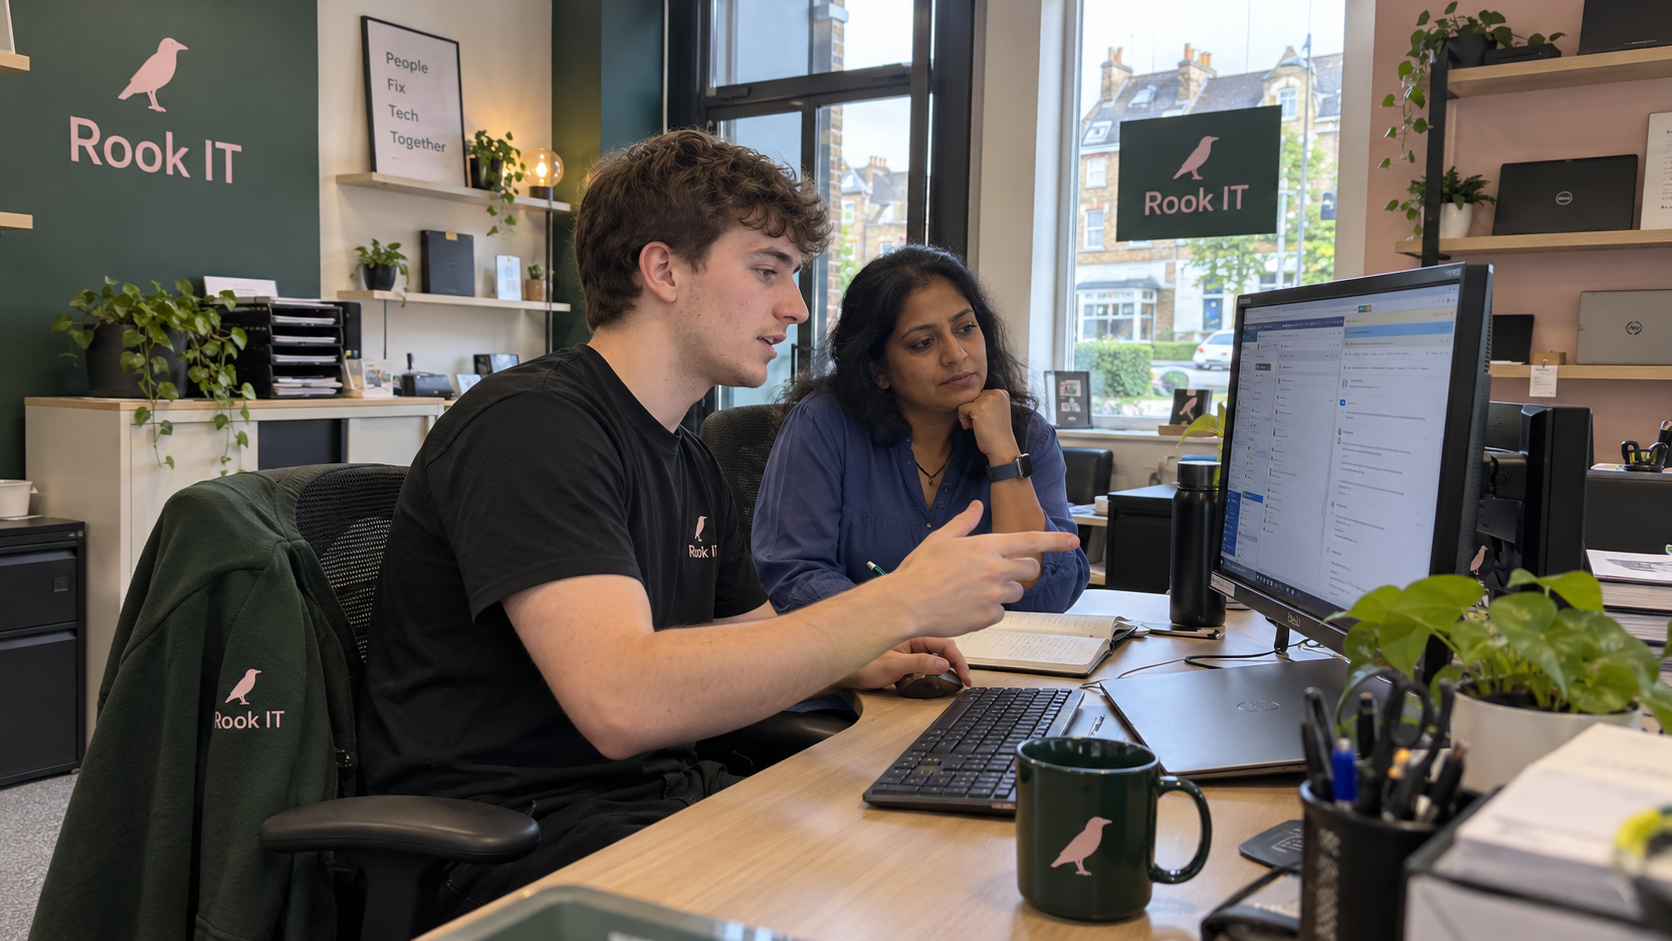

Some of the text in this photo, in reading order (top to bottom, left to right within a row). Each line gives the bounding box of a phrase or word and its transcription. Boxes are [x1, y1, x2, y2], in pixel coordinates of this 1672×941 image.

[386, 51, 429, 74] People
[387, 78, 406, 94] Fix
[388, 104, 419, 122] Tech
[69, 115, 242, 184] Rook IT
[390, 130, 447, 153] Together
[1144, 184, 1249, 216] Rook IT
[688, 544, 709, 559] Rook
[214, 710, 285, 730] Rook IT
